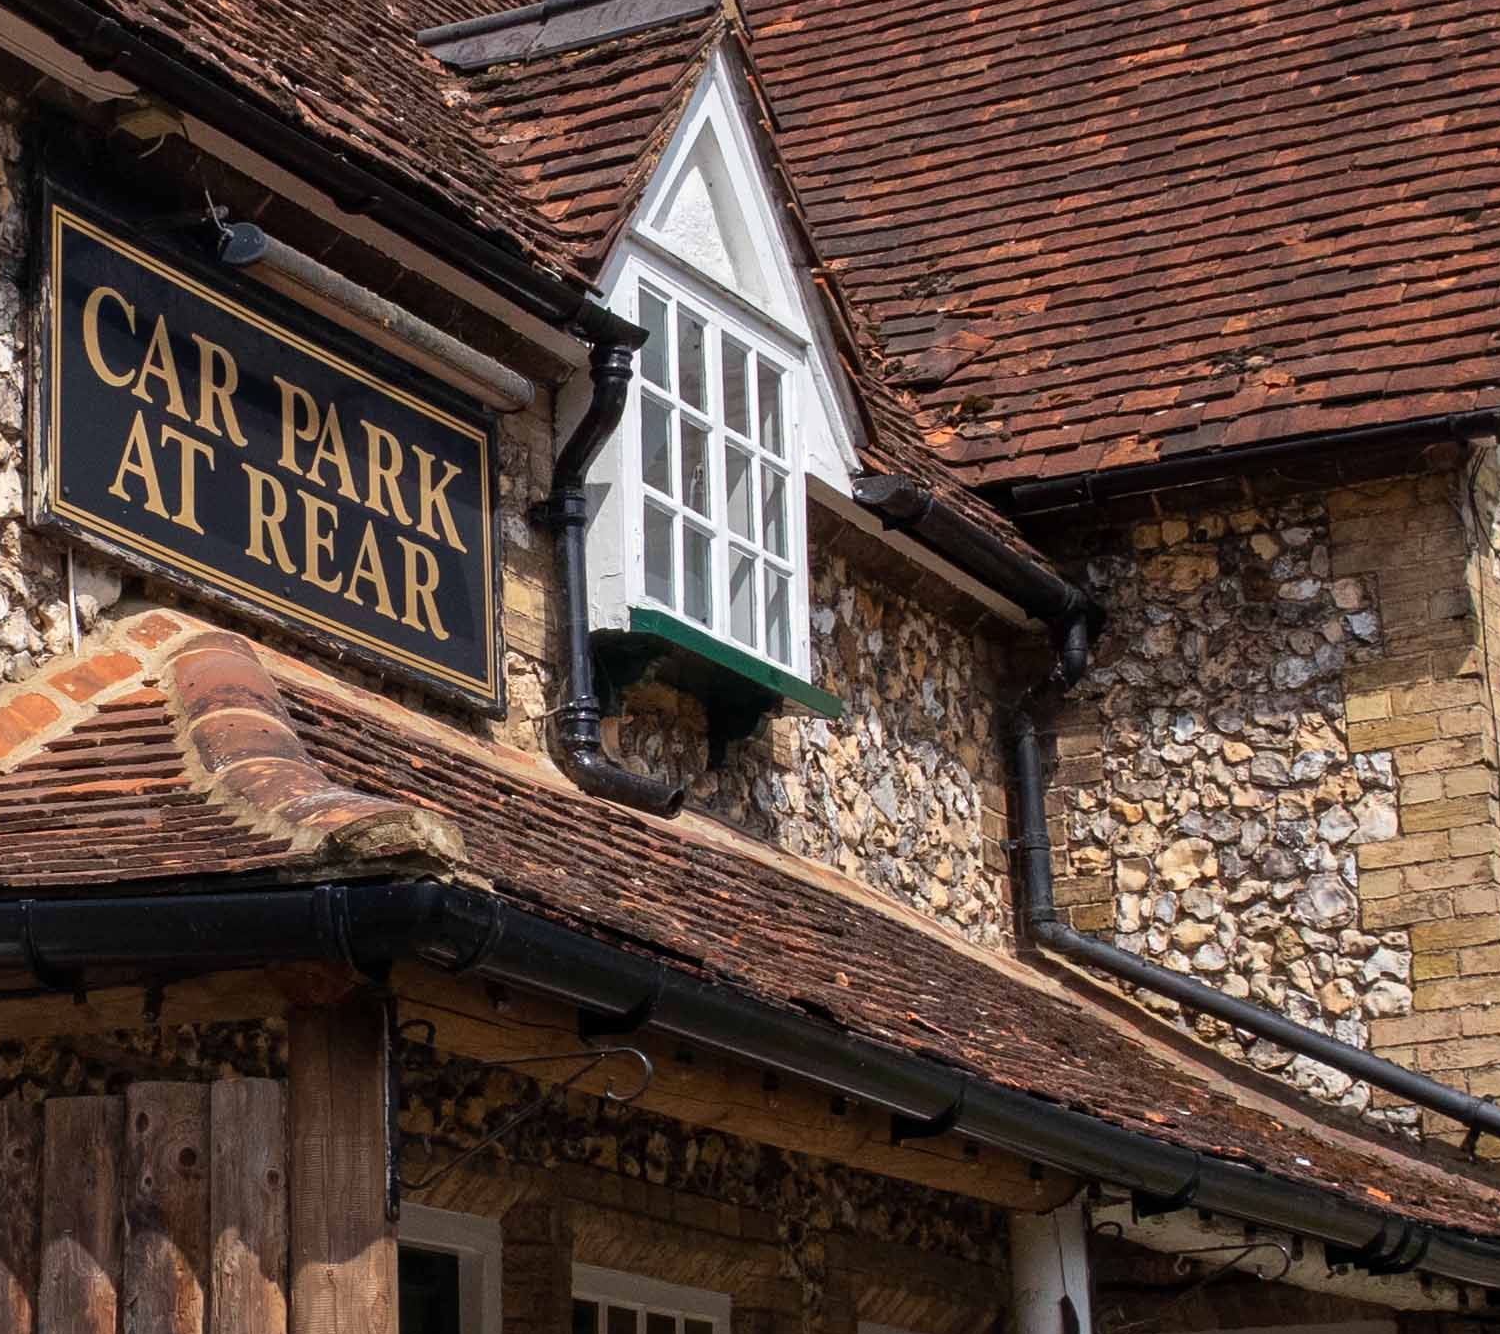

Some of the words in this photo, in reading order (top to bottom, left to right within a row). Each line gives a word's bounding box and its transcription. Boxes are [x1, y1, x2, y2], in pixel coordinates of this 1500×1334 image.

[83, 286, 248, 447] CAR
[274, 375, 469, 554] PARK
[107, 409, 216, 535] AT
[241, 462, 450, 642] REAR
